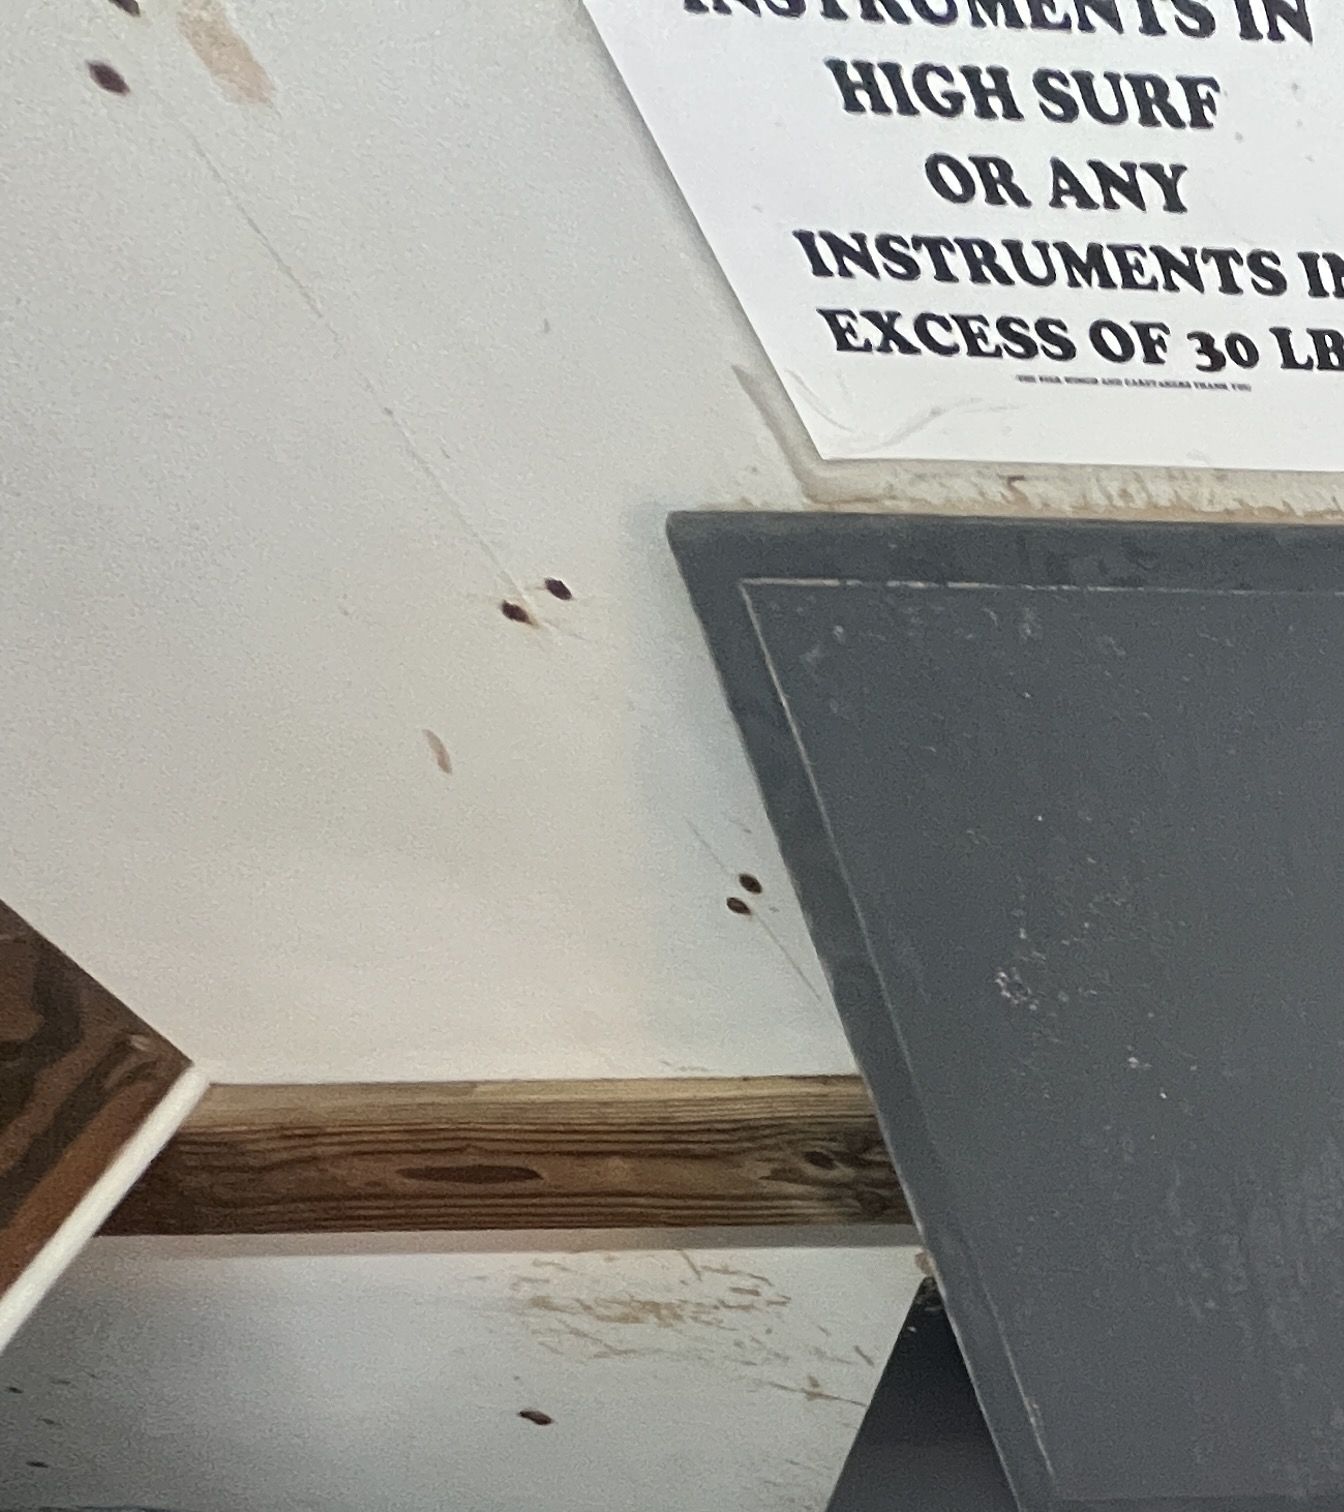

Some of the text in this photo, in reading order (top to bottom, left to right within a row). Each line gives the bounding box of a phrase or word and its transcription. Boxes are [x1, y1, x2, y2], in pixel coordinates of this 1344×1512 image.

[1234, 0, 1313, 43] IN
[825, 58, 1221, 129] HIGH SURF
[924, 153, 1188, 214] OR ANY
[792, 230, 1288, 297] INSTRUMENTS
[817, 308, 1077, 362] EXCESS
[1089, 319, 1171, 365] OF
[1186, 331, 1260, 373] 30
